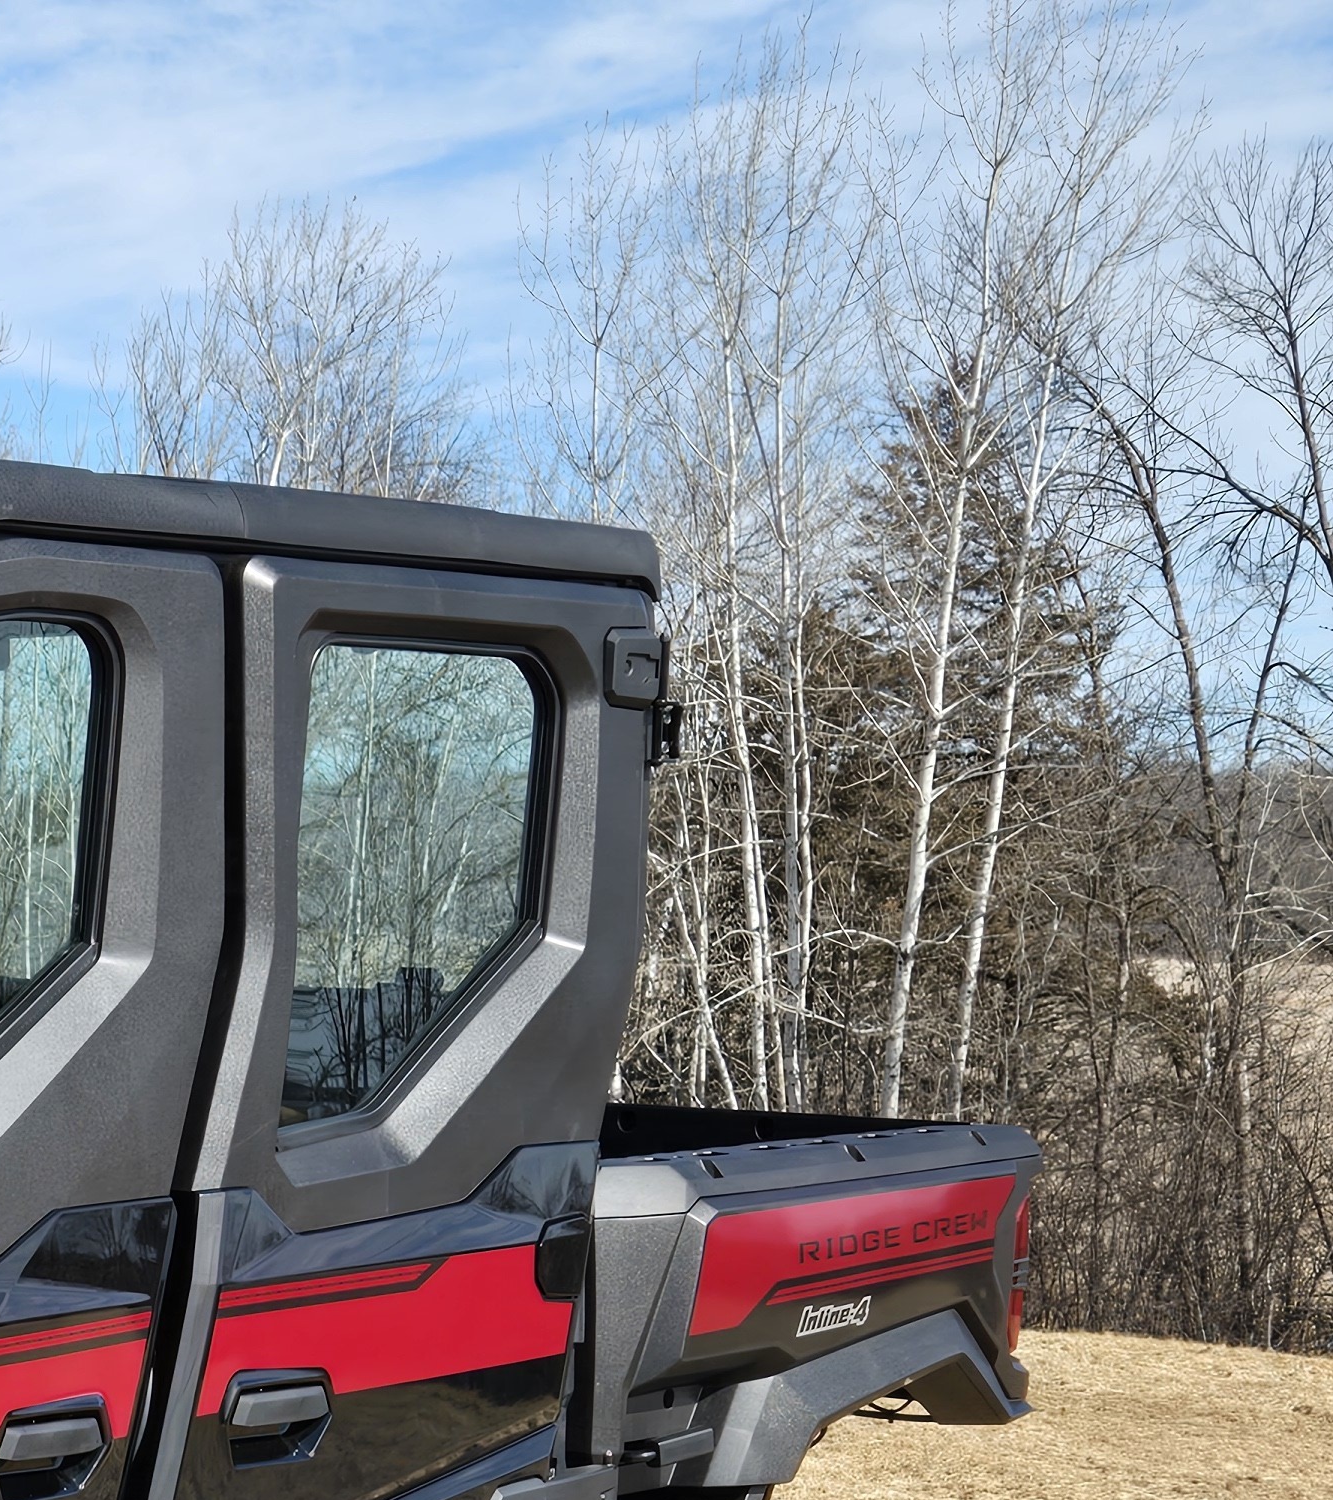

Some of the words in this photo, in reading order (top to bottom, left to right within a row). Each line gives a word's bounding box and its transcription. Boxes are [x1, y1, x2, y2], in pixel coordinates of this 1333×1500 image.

[798, 1227, 901, 1264] RIDGE
[913, 1210, 988, 1243] CREW
[796, 1296, 872, 1338] Inline-4
